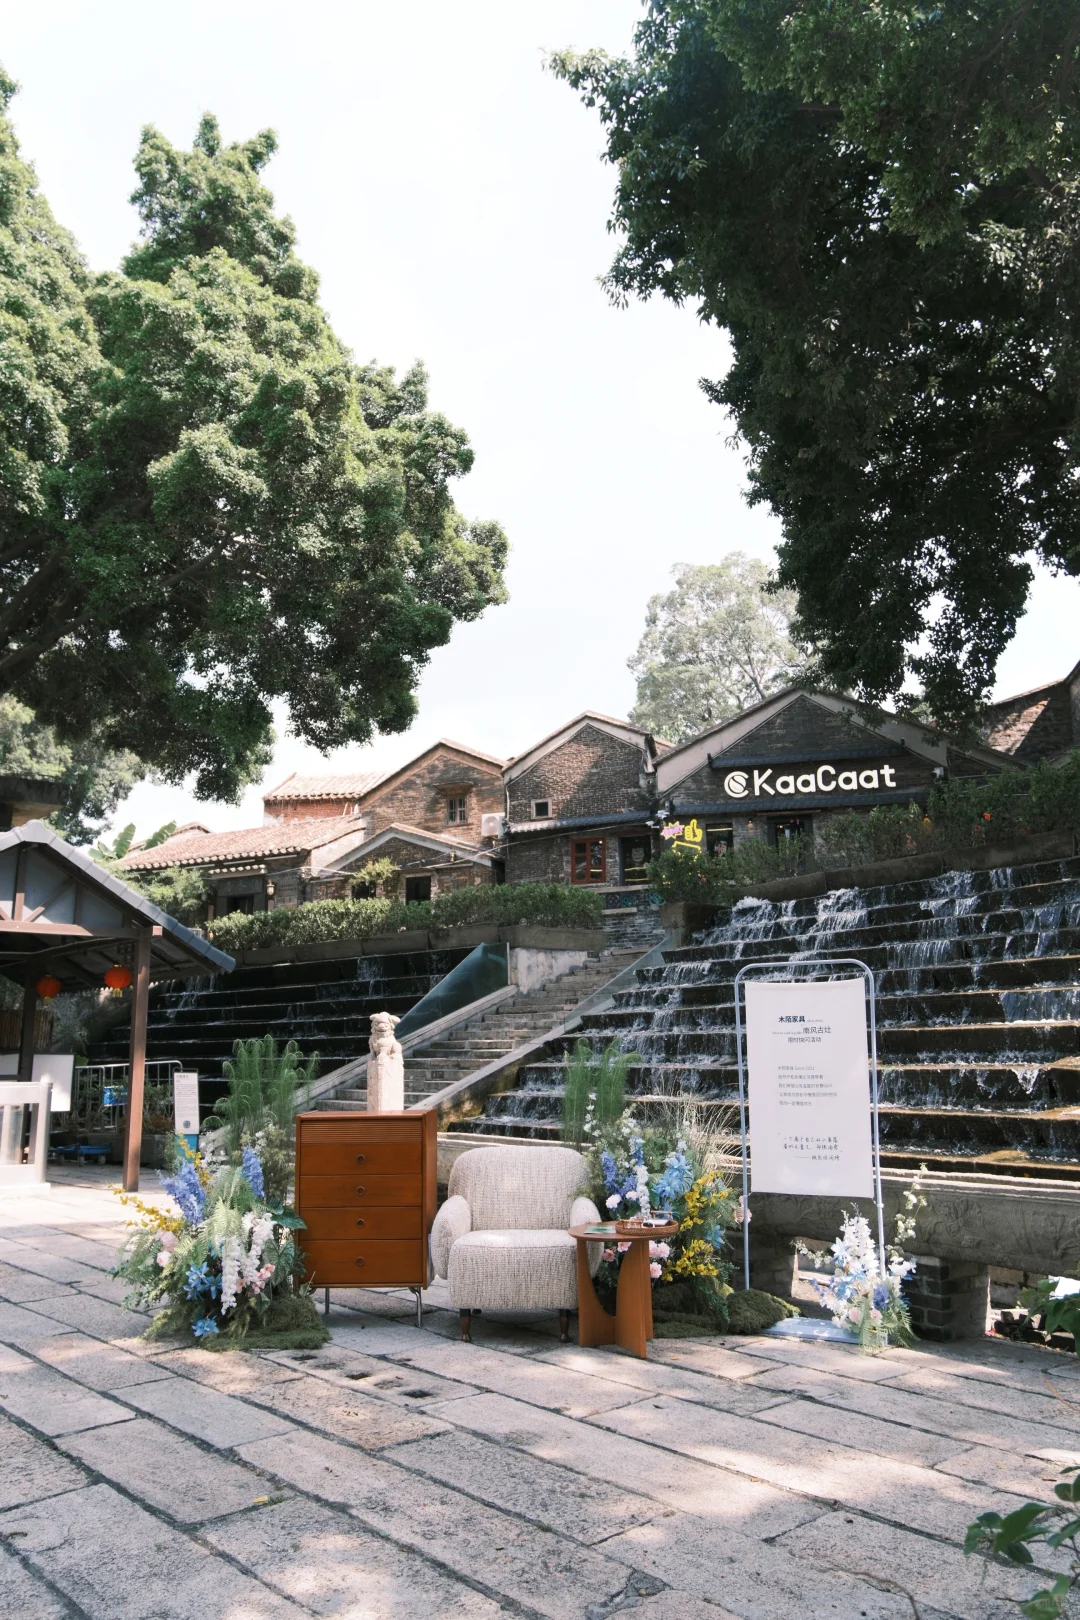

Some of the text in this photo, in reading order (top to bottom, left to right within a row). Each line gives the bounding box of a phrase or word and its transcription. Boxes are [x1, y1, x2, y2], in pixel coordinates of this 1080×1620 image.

[753, 764, 897, 796] KaaCaat
[778, 1015, 806, 1024] 木陌家具
[802, 1026, 832, 1035] 南风古灶
[787, 1036, 822, 1044] 限时快闪活动
